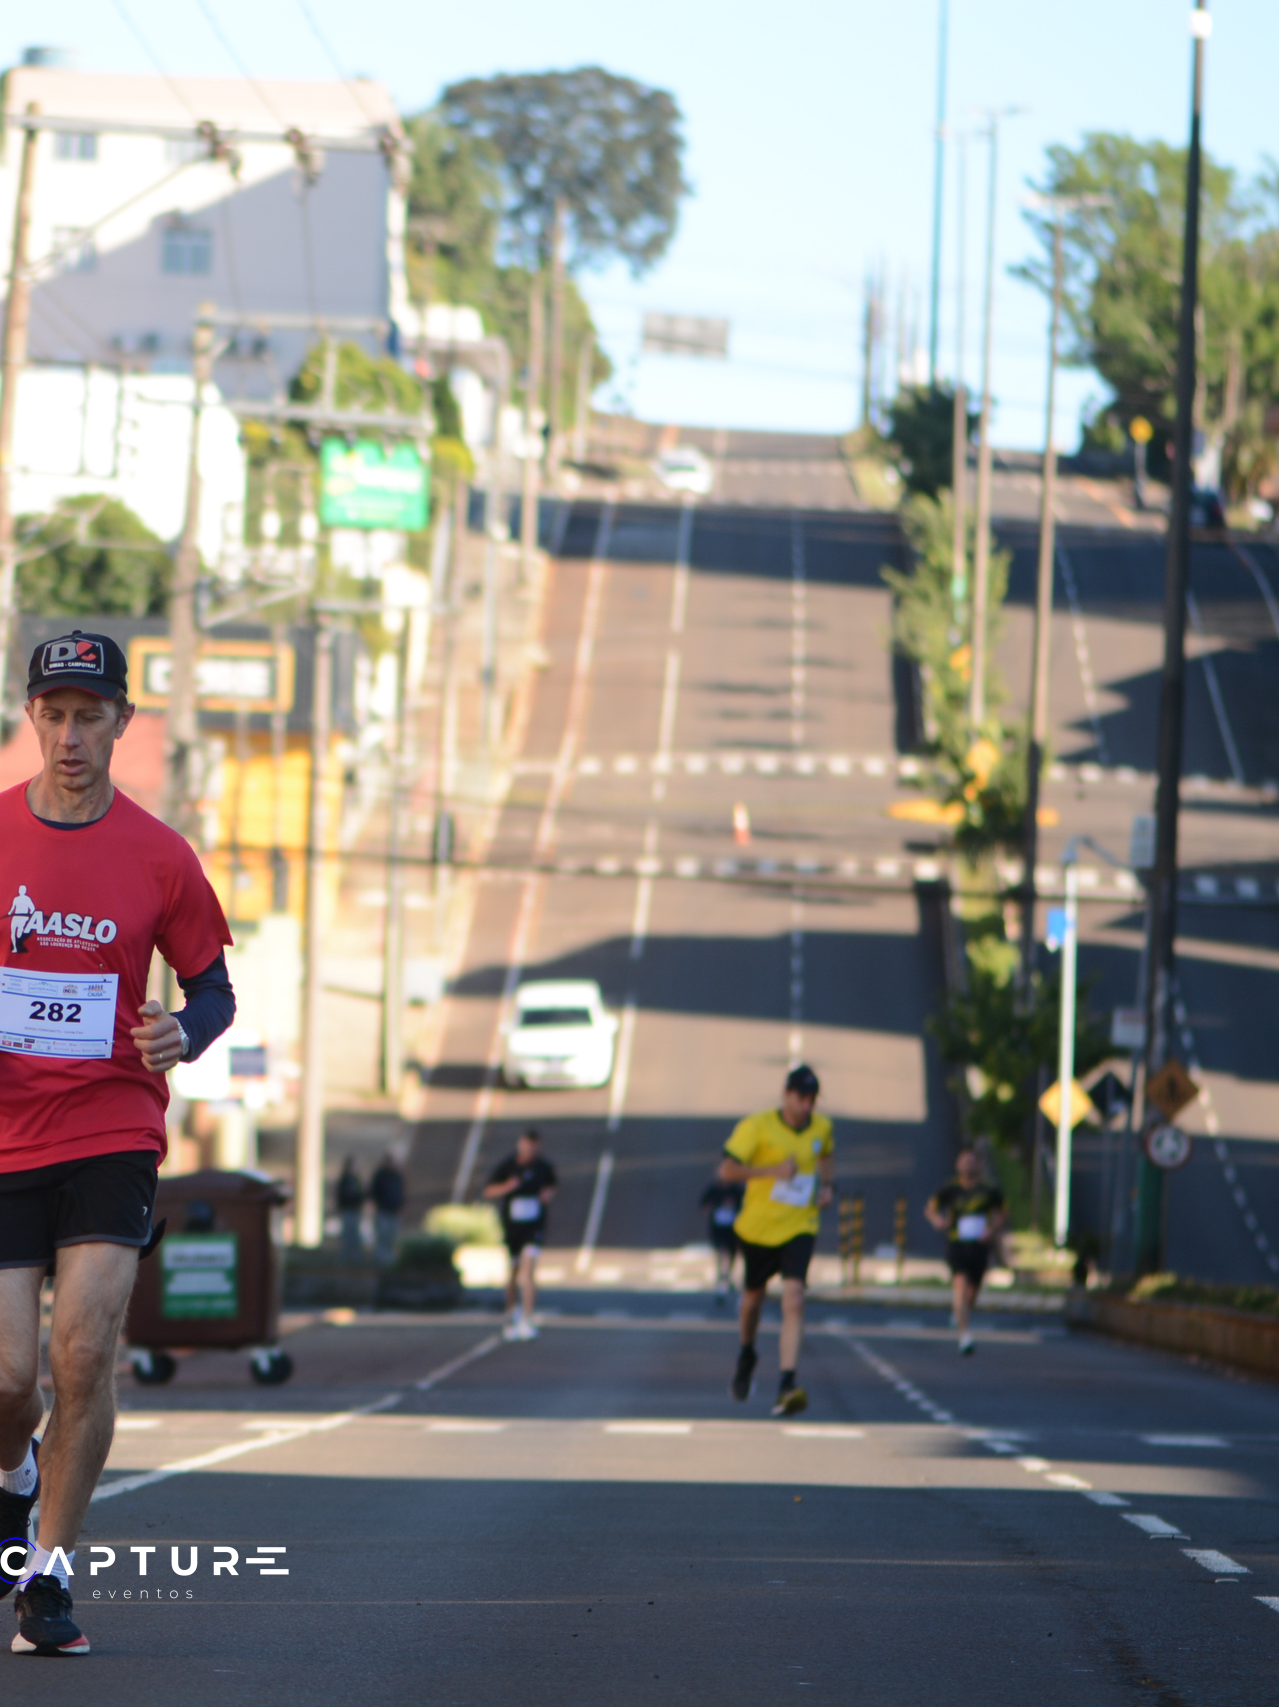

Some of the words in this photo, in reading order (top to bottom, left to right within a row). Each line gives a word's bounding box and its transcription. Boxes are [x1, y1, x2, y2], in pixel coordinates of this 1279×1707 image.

[23, 911, 117, 944] AASLO
[74, 939, 99, 948] ATLETISMO
[29, 1001, 82, 1023] 282
